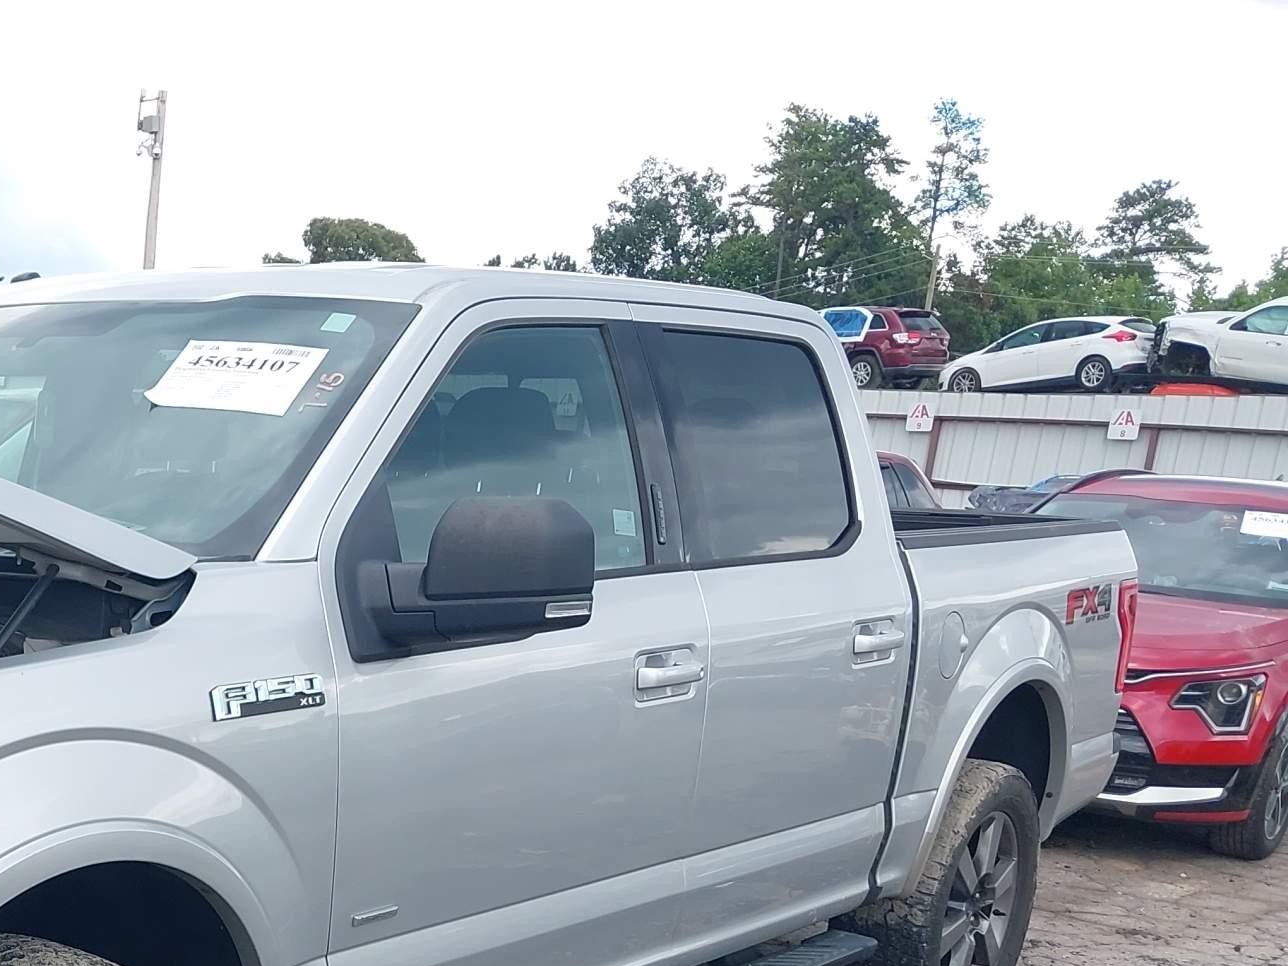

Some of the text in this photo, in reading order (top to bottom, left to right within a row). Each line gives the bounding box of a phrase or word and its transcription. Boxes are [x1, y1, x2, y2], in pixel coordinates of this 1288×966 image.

[188, 355, 300, 374] 45634107
[1065, 584, 1112, 624] FX4
[299, 695, 322, 707] XLT
